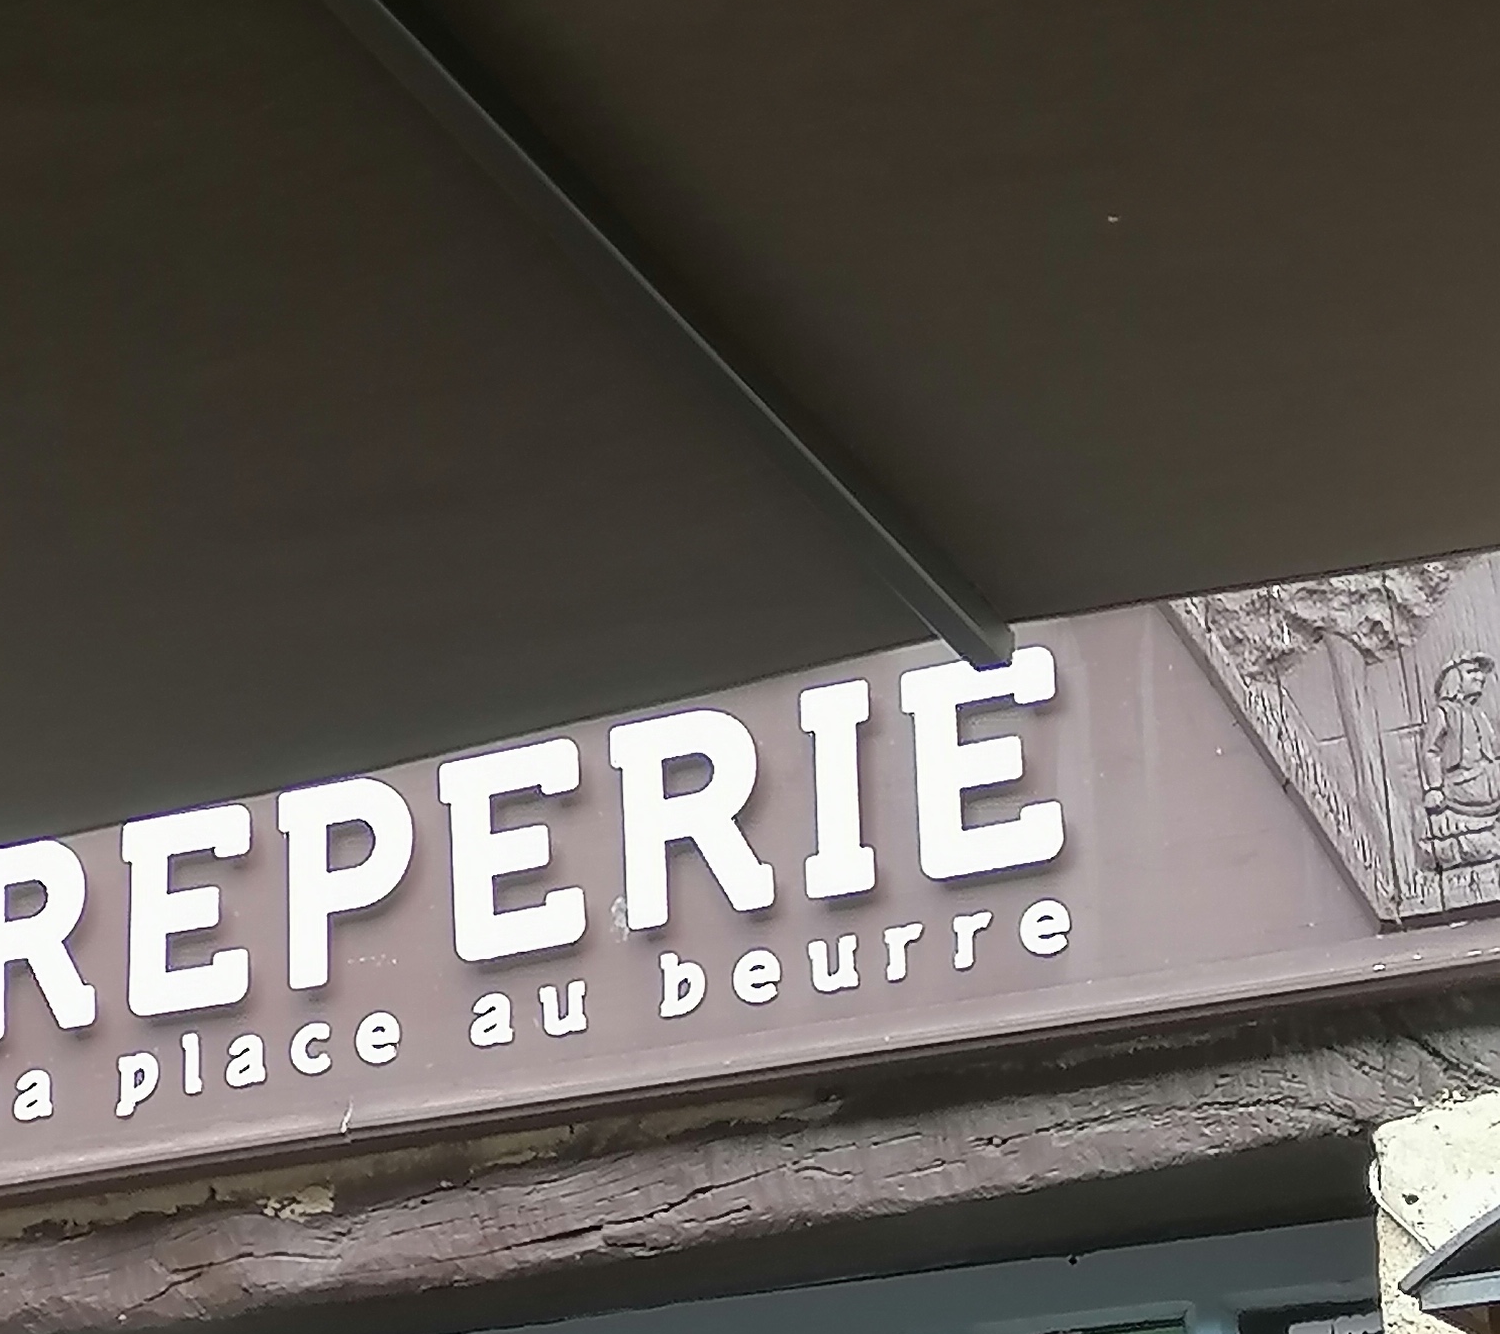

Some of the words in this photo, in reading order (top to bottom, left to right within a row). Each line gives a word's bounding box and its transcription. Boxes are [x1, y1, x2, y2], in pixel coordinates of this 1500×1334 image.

[116, 1003, 402, 1117] place
[469, 979, 590, 1047] au
[657, 895, 1073, 1020] beurre
